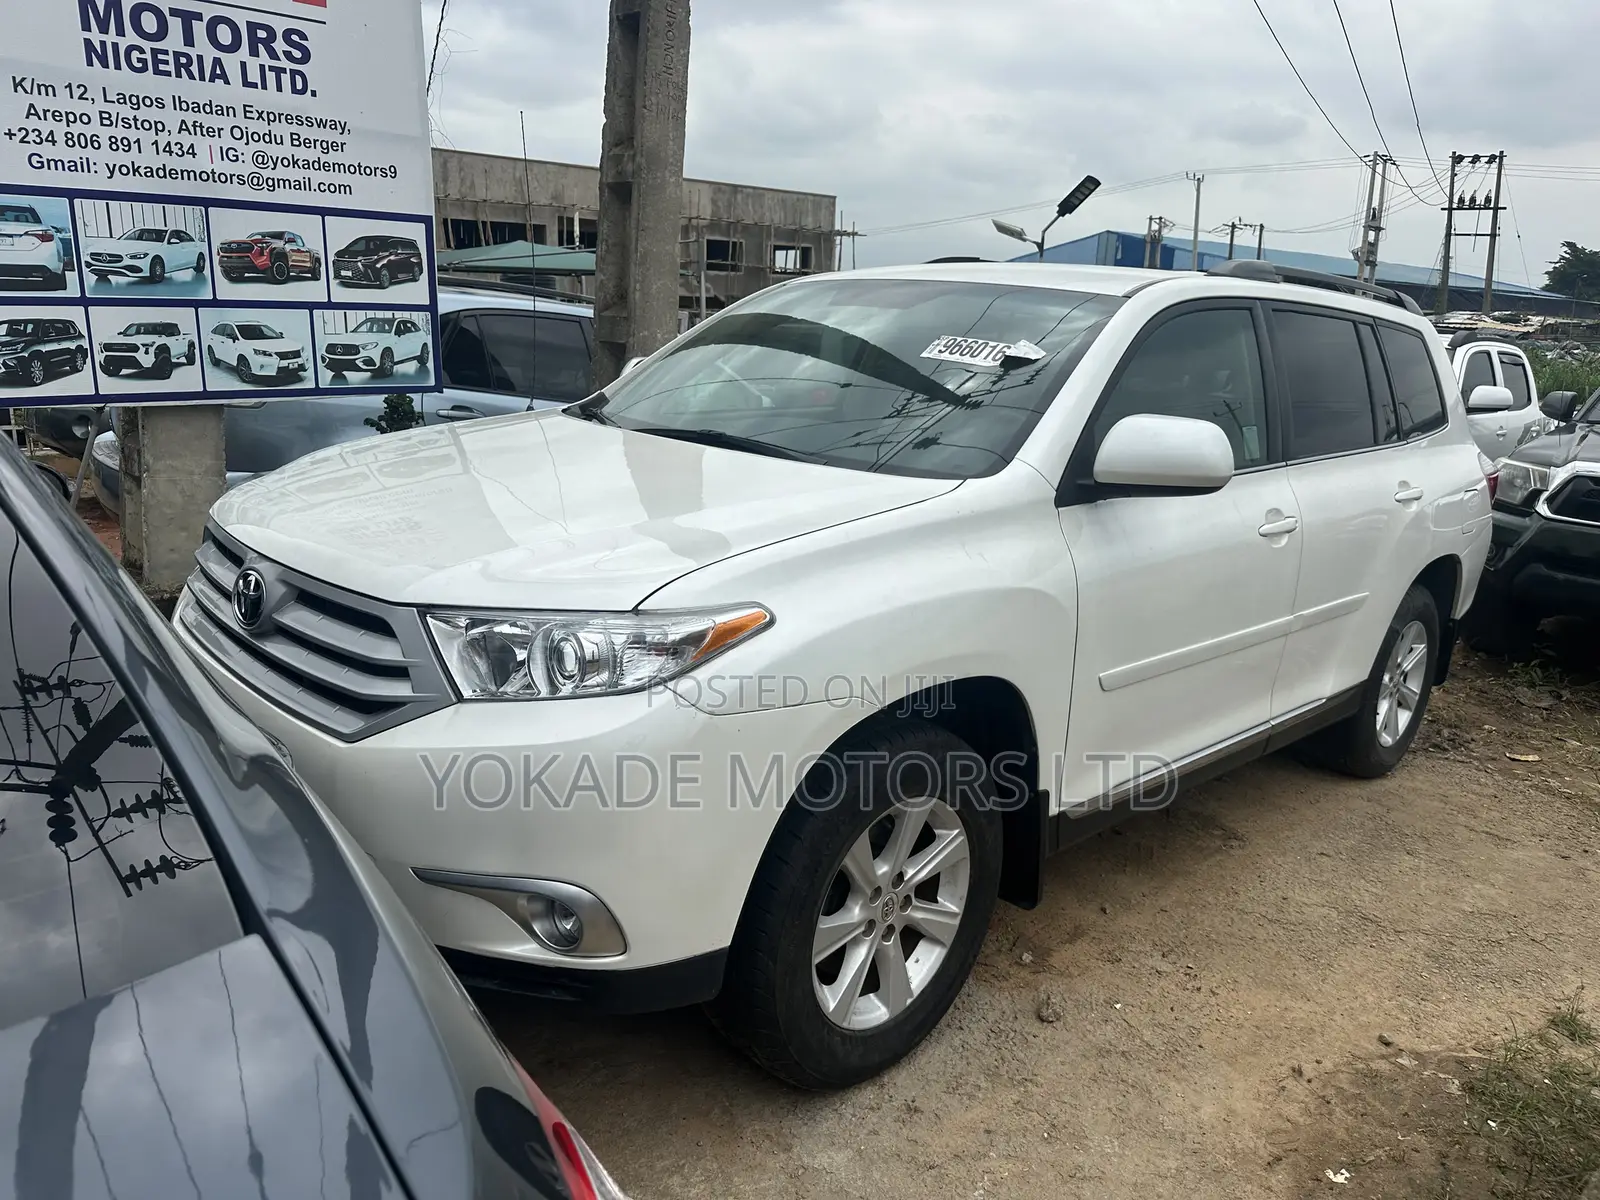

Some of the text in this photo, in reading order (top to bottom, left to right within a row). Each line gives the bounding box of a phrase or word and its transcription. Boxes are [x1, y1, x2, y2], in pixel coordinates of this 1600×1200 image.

[77, 0, 312, 66] MOTORS
[662, 0, 678, 76] HONORIF
[82, 37, 318, 98] NIGERIA LITD.
[11, 75, 351, 136] K/m 12, Lagos Ibadan Expressway,
[24, 102, 347, 155] Arepo B/stop, After Ojodu Berger
[3, 126, 398, 180] +234 806 891 1434 IG: @yokademotors9
[27, 152, 353, 196] Gmail: yokademotors@gmail.com
[937, 337, 1012, 363] 966016
